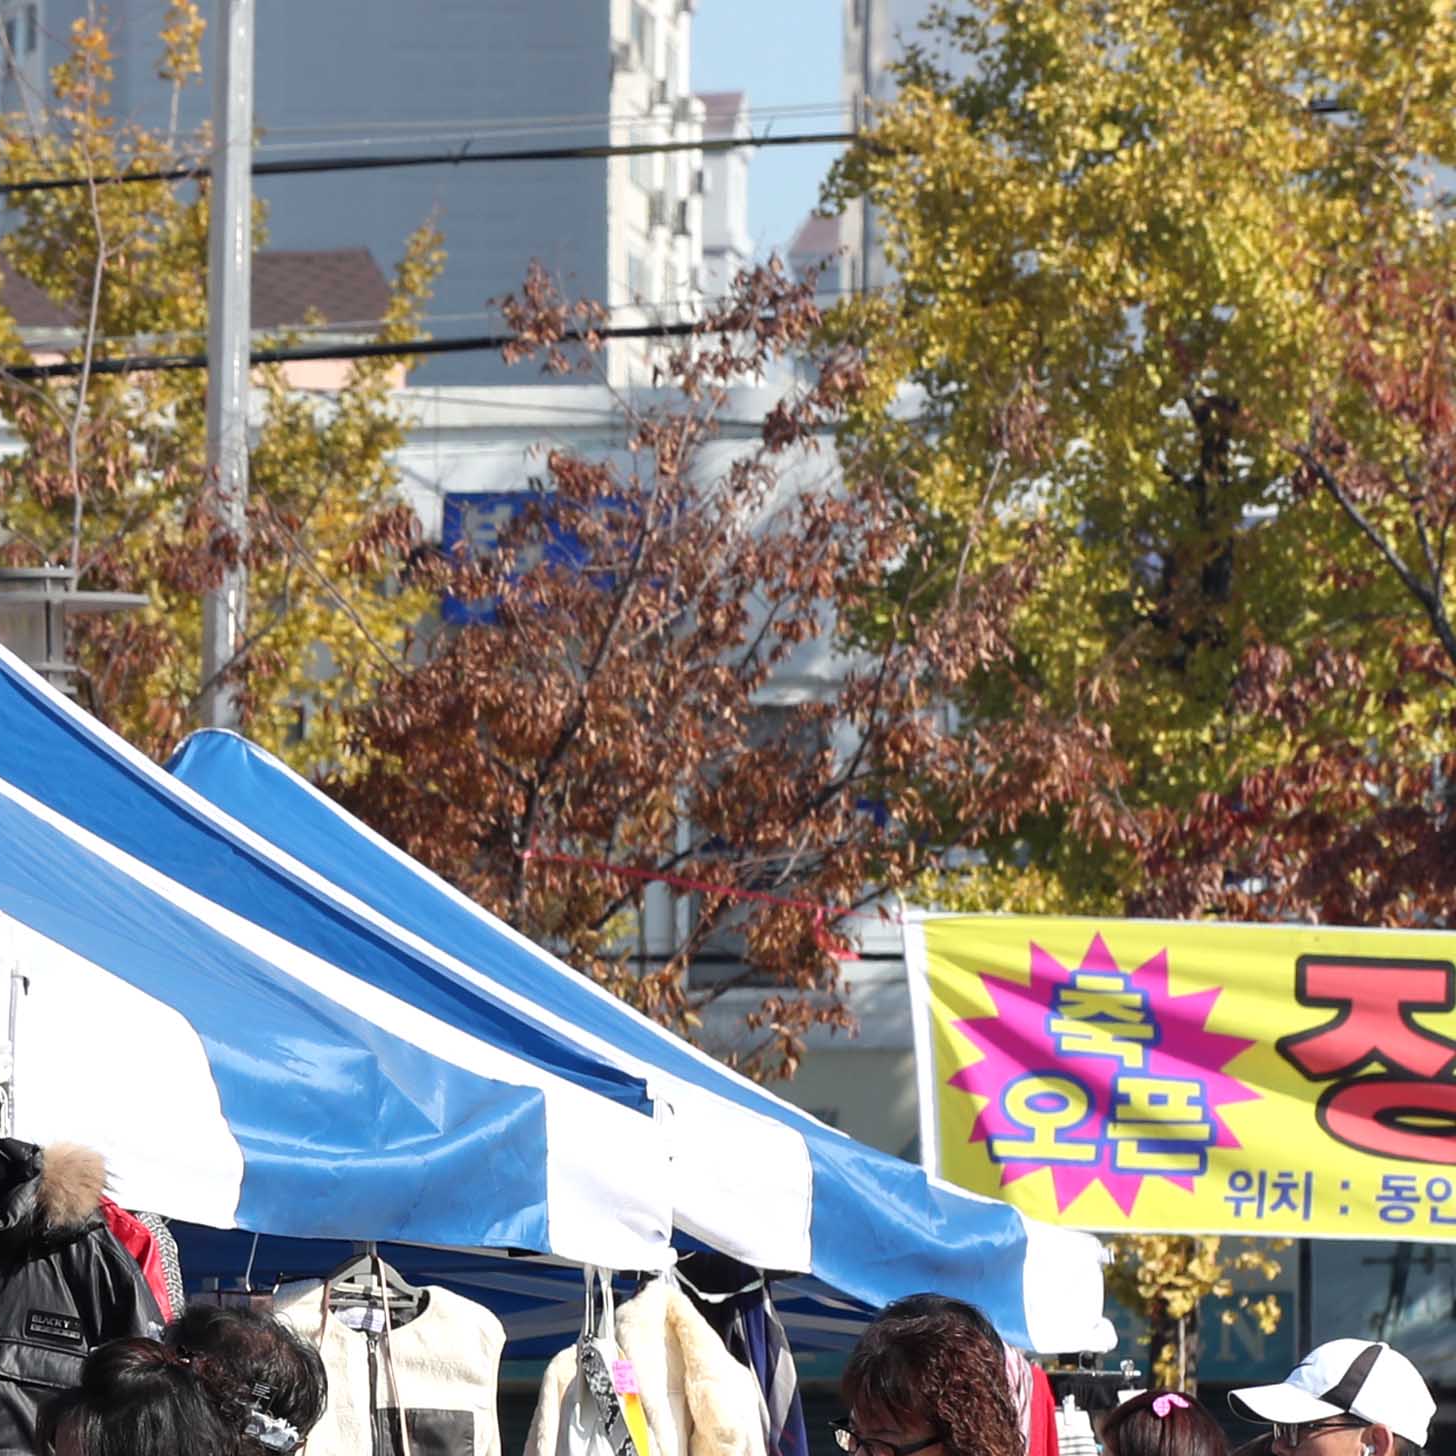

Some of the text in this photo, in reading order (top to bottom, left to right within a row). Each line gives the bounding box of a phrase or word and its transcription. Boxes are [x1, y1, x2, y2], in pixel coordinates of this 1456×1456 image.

[1045, 969, 1162, 1074] 축
[987, 1069, 1218, 1175] 오픈
[1224, 1170, 1313, 1221] 위치
